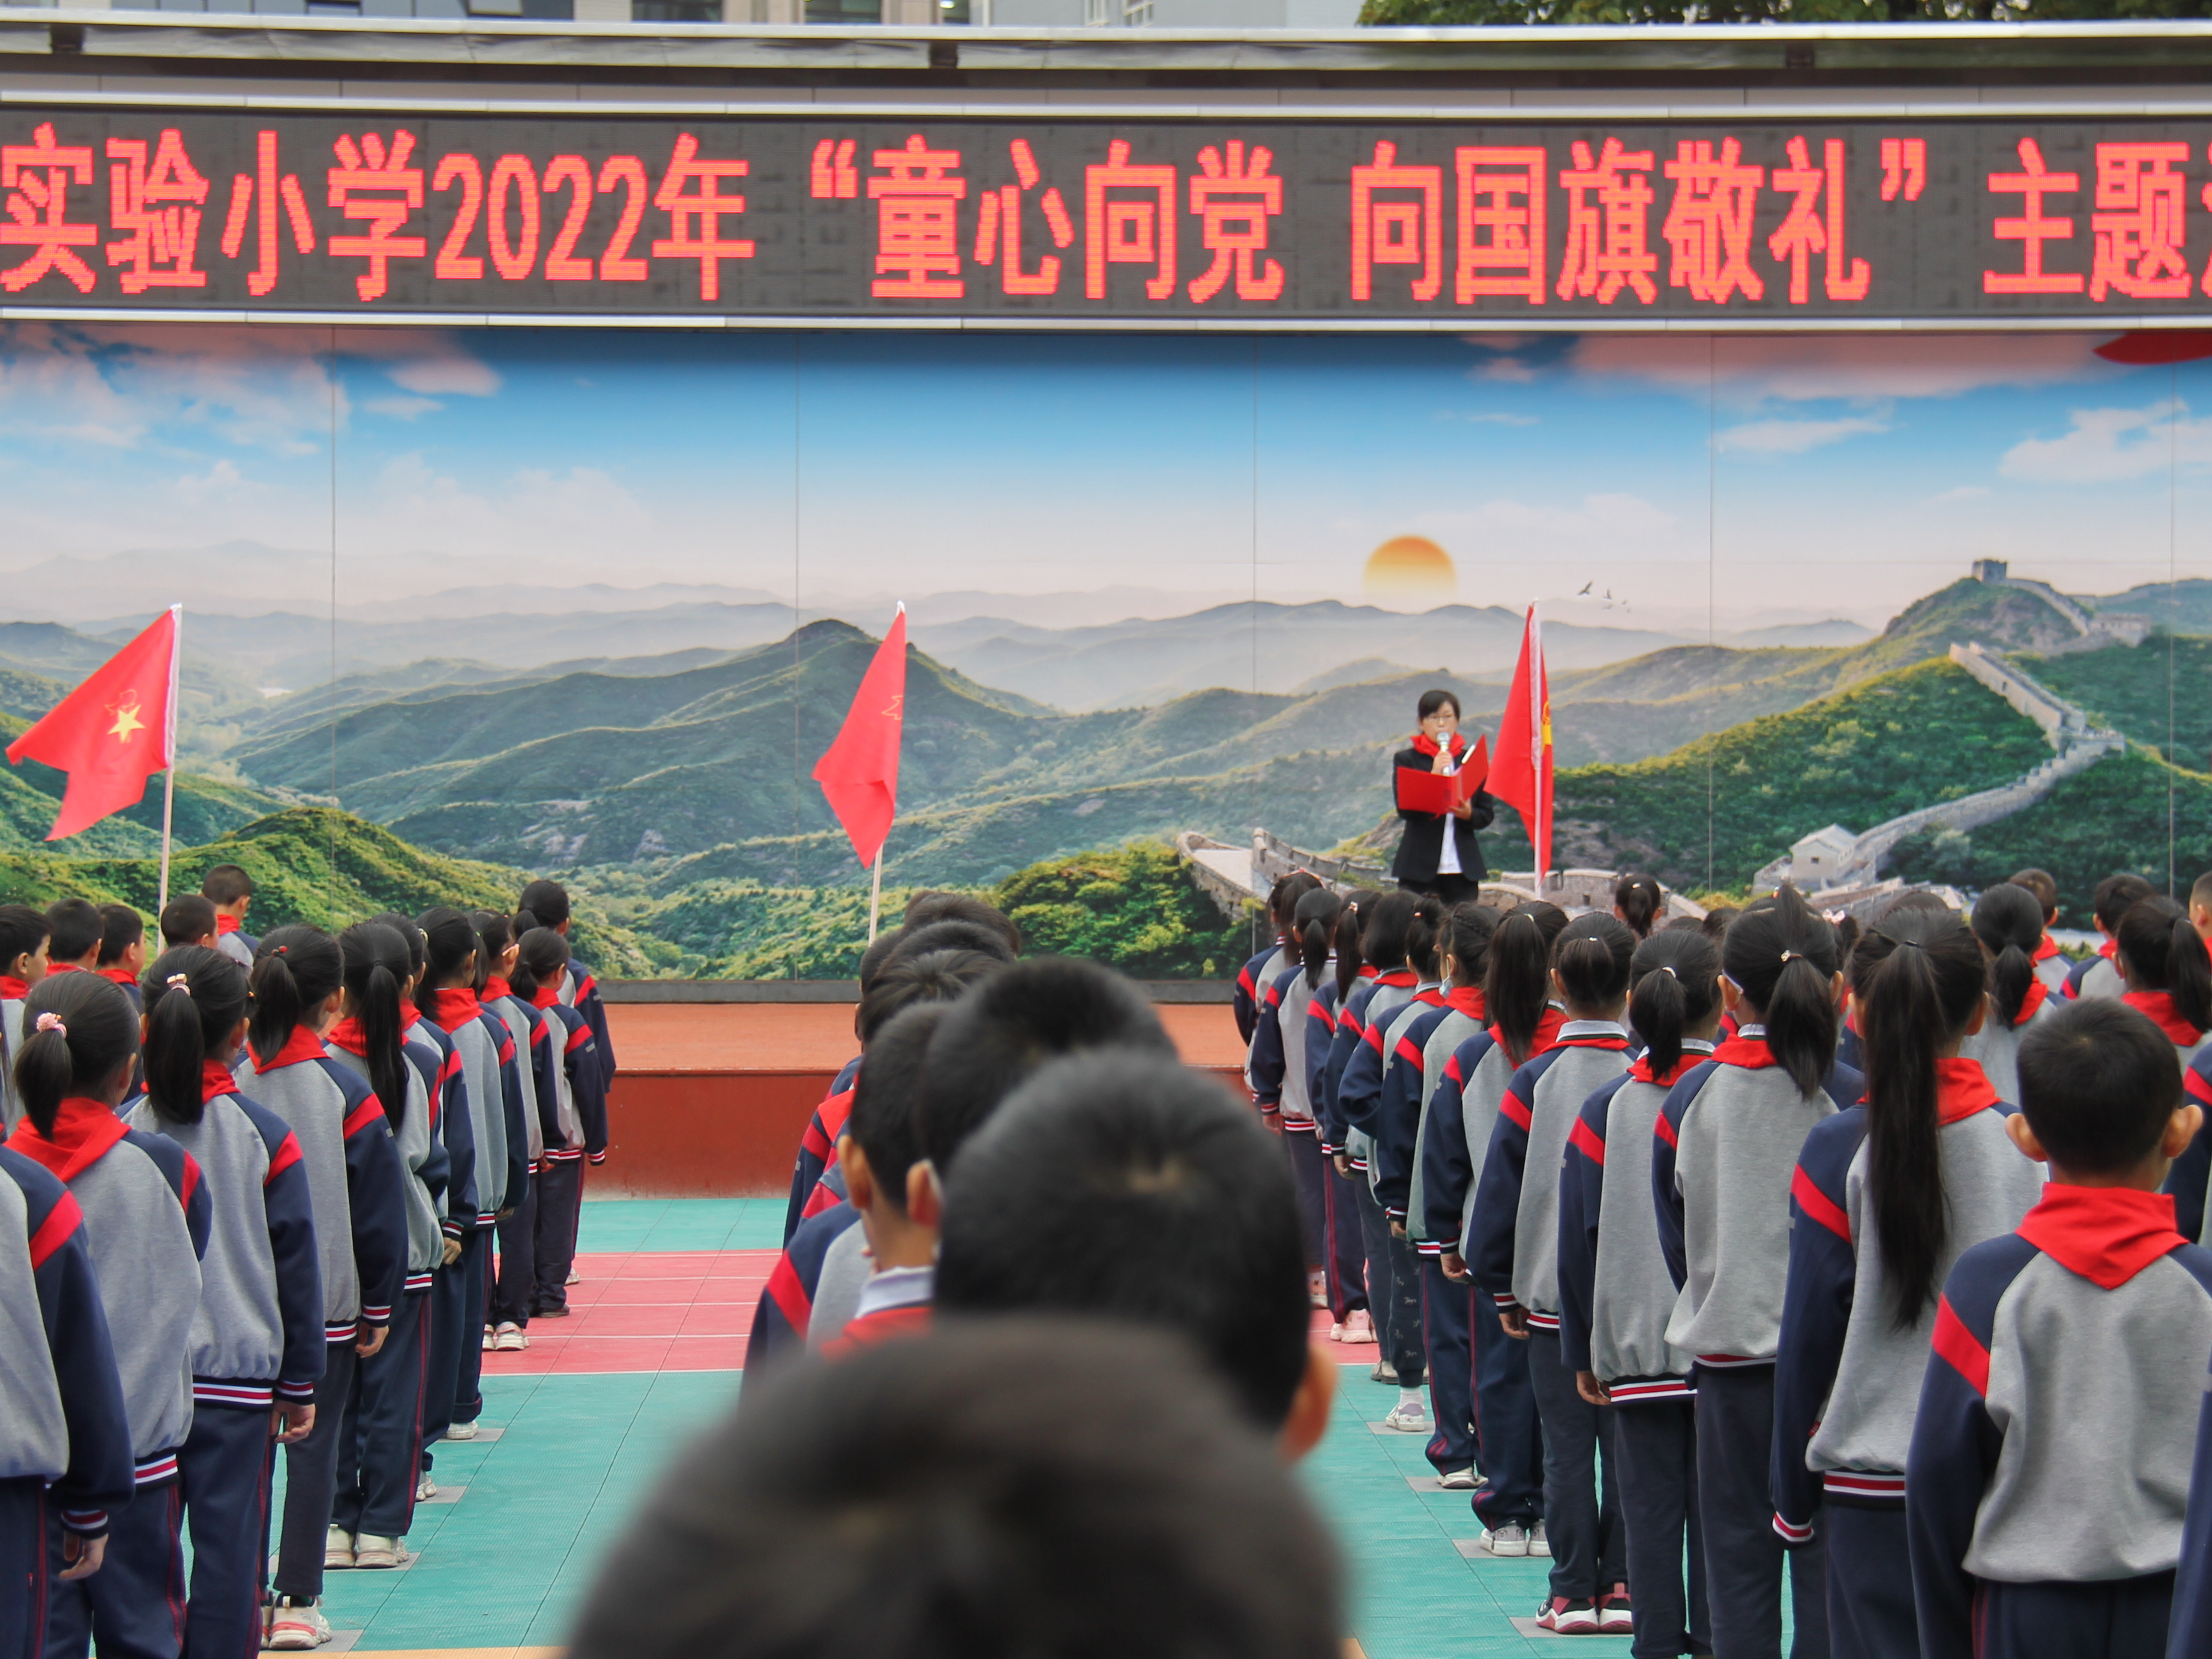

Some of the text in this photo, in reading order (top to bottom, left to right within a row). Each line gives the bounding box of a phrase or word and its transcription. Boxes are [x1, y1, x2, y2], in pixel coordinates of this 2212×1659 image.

[0, 122, 756, 301] 实验小学2022年
[1982, 137, 2212, 303] 主题
